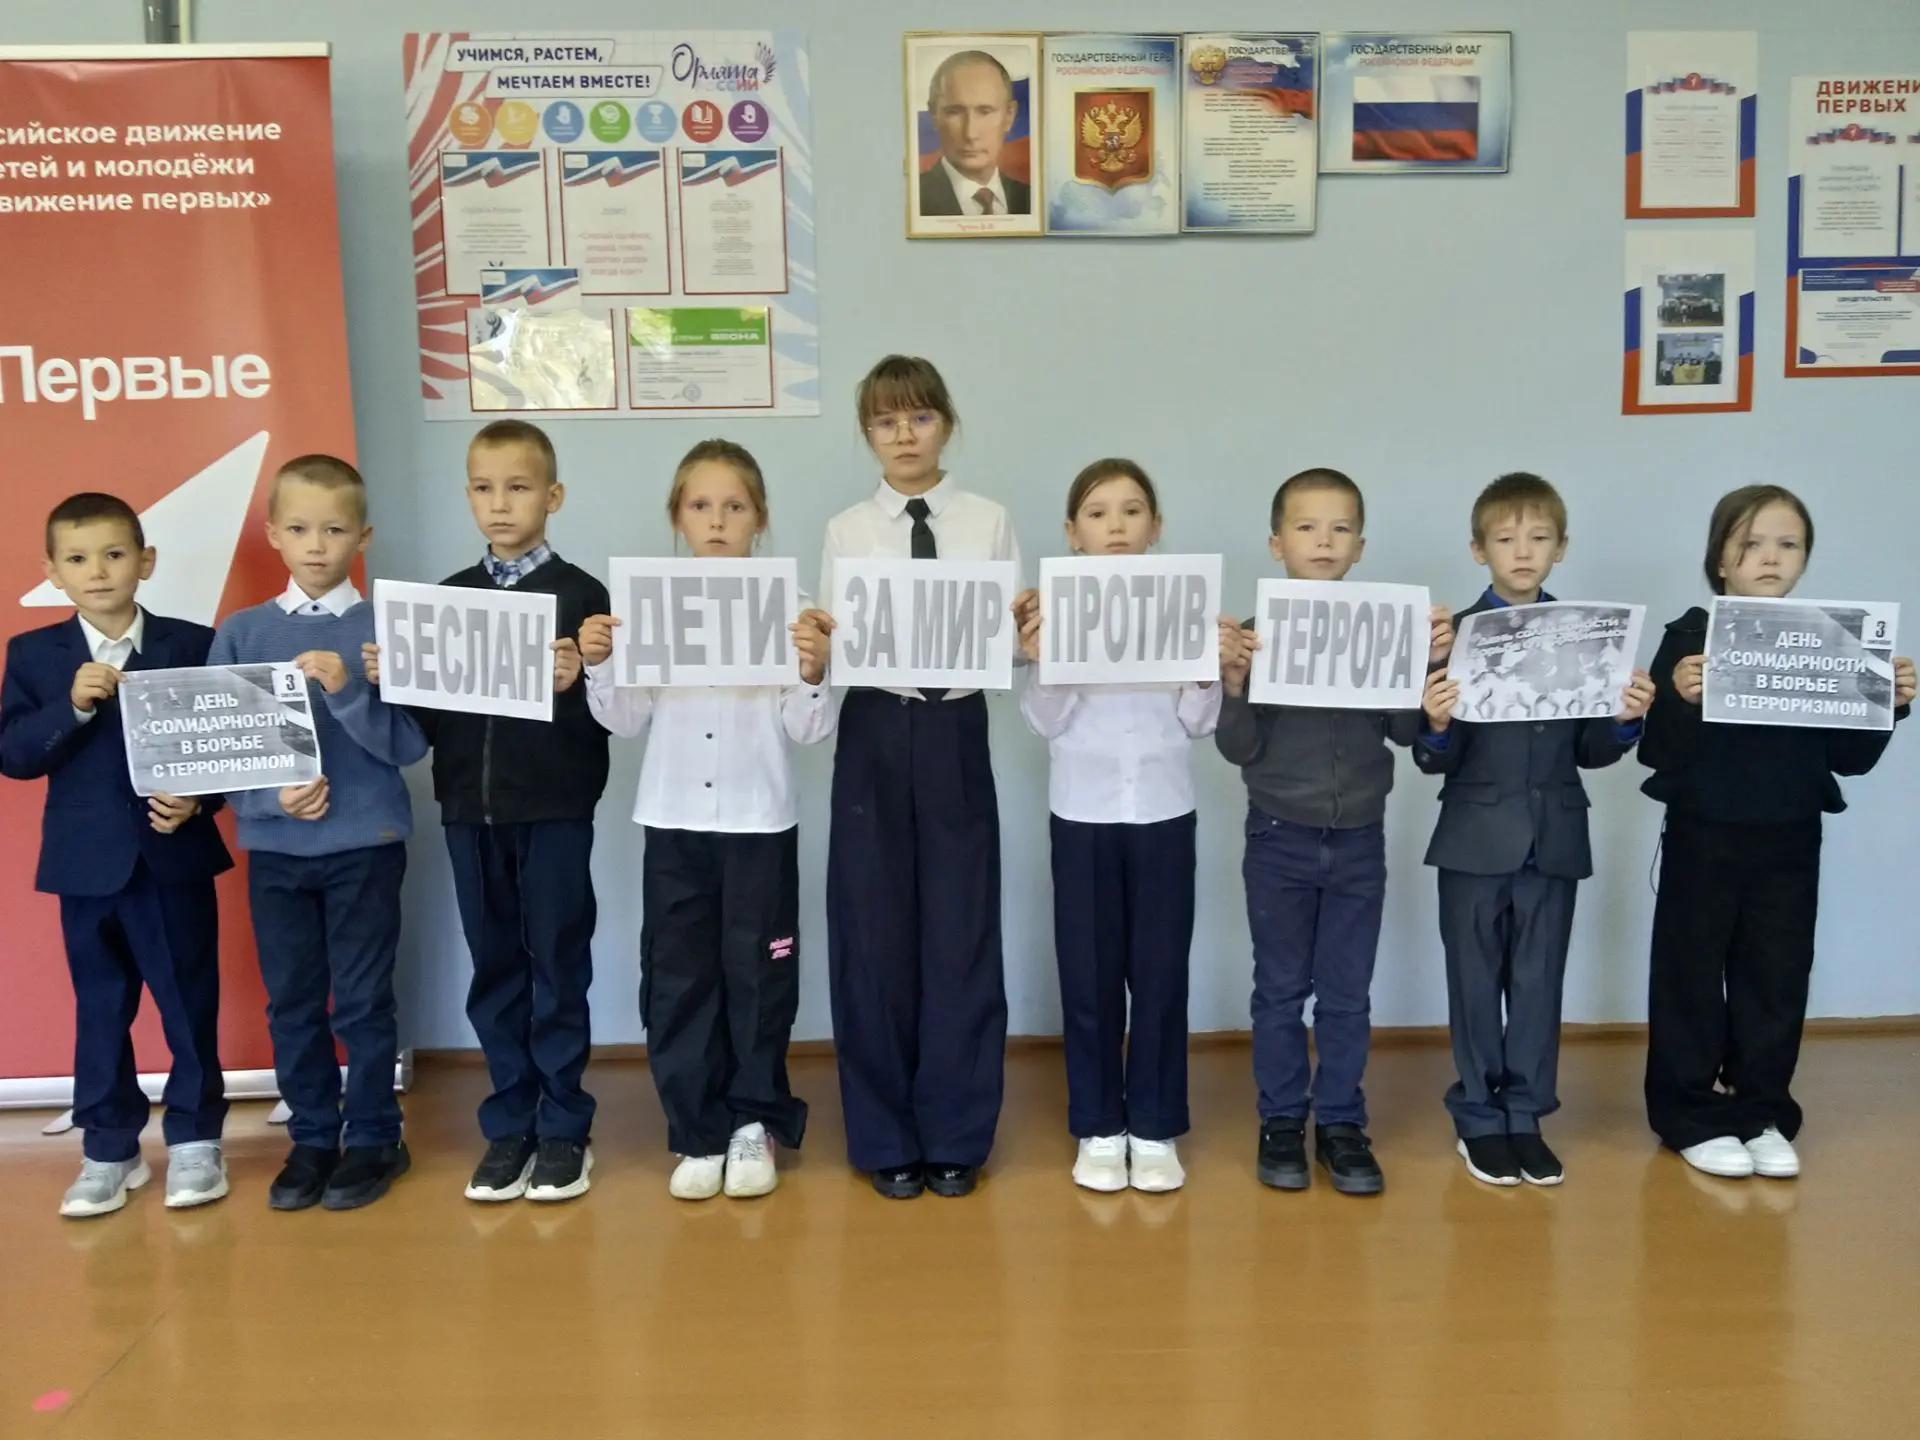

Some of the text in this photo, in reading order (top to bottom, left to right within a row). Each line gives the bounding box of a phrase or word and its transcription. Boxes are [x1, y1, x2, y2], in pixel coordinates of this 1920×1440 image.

[457, 47, 604, 63] УЧИМСЯ, РАСТЕМ,
[1051, 52, 1146, 64] ГОСУДАРСТВЕННЫЙ
[1350, 42, 1482, 55] ГОСУДАРСТВЕННЫЙ ФЛАГ
[497, 74, 651, 90] МЕЧТАЕМ ВМЕСТЕ!
[1816, 98, 1907, 114] ПЕРВЫХ
[124, 122, 282, 147] движение
[67, 160, 86, 178] и
[94, 152, 255, 179] молодёжи
[142, 190, 272, 215] первых»
[0, 344, 272, 421] Первые
[626, 575, 787, 685] ДЕТИ
[842, 575, 1001, 671] ЗА МИР
[1049, 573, 1208, 664] ПРОТИВ
[1875, 620, 1886, 638] 3
[1266, 597, 1413, 689] ТЕРРОРА
[1774, 630, 1823, 649] ДЕНЬ
[384, 599, 546, 704] БЕСЛАН
[1730, 650, 1867, 673] СОЛИДАРНОСТИ
[285, 674, 295, 691] 3
[1756, 674, 1840, 693] В БОРЬБЕ
[192, 692, 239, 712] ДЕНЬ
[1725, 693, 1868, 717] С ТЕРРОРИЗМОМ
[150, 712, 287, 735] СОЛИДАРНОСТИ
[181, 735, 264, 755] В БОРЬБЕ
[152, 754, 295, 779] С ТЕРРОРИЗМОМ
